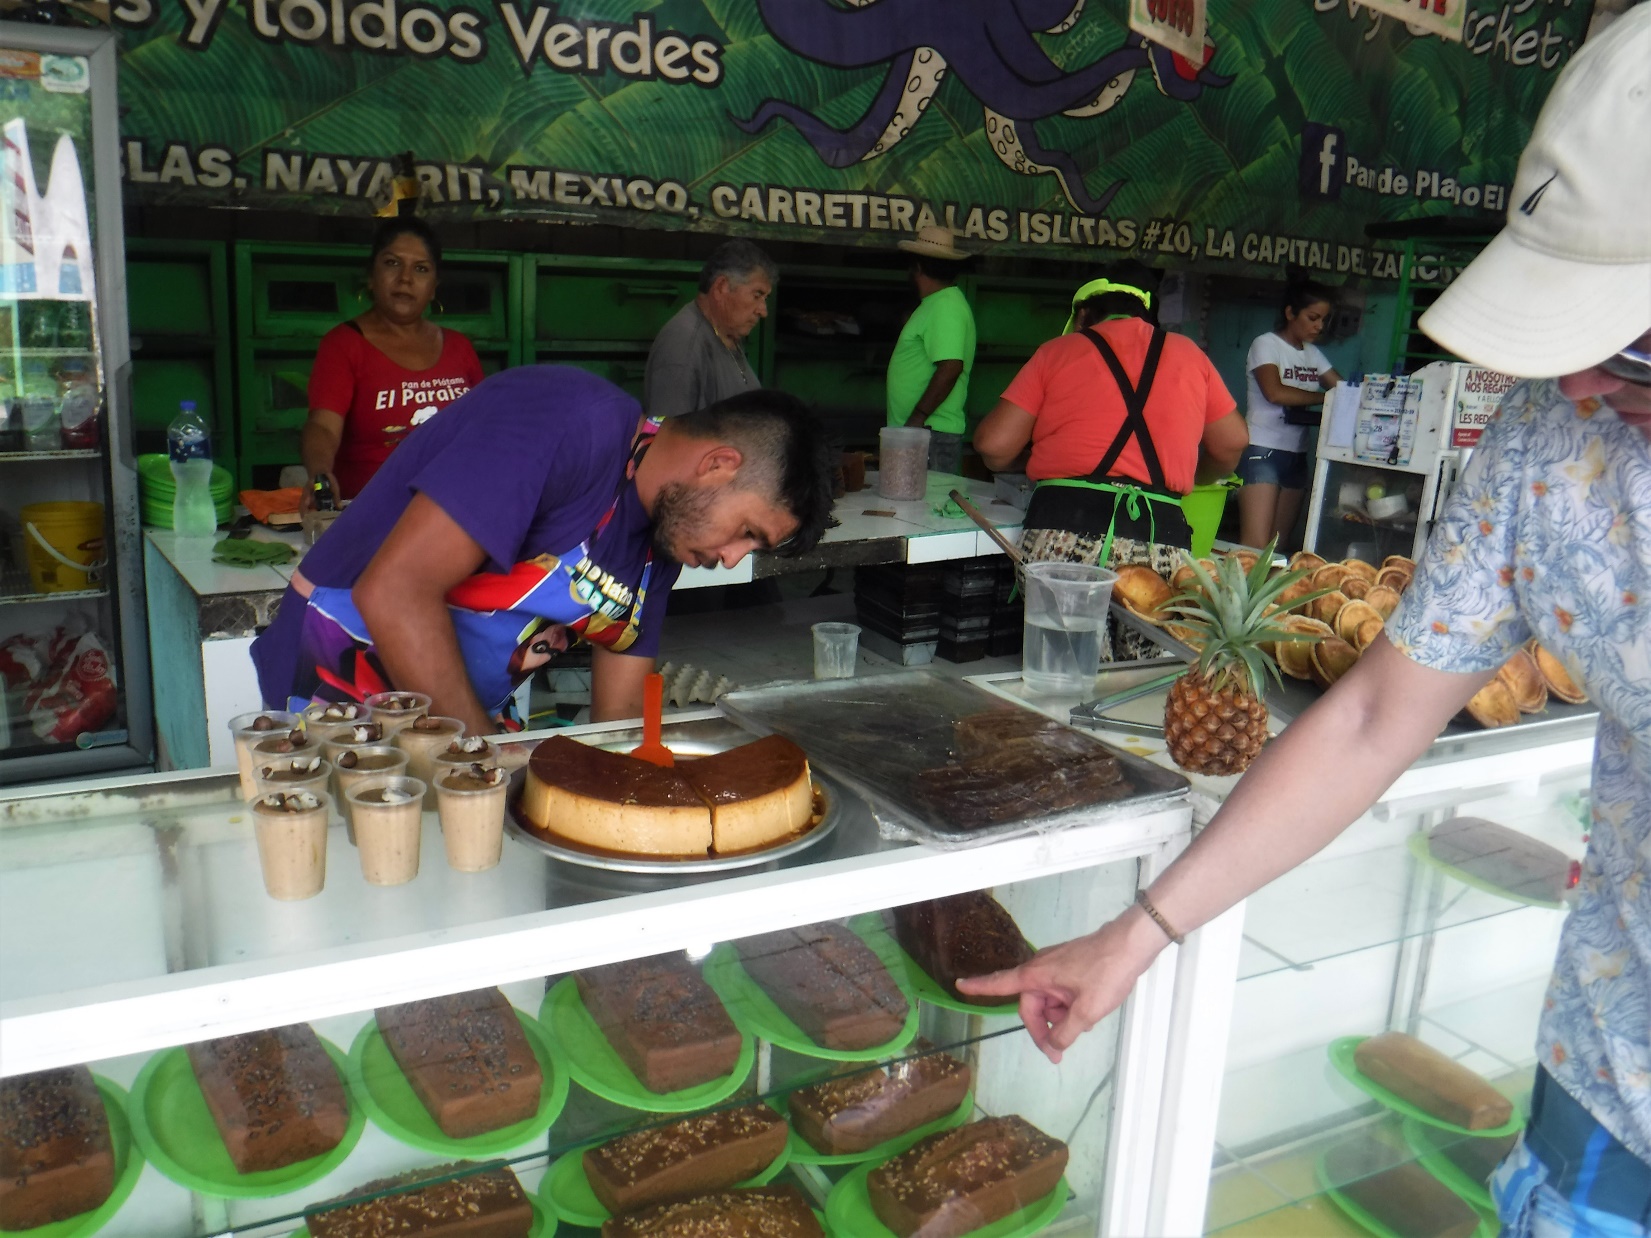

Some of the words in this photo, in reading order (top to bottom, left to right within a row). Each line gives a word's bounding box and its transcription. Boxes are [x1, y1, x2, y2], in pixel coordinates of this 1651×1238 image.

[253, 0, 482, 59] toldos
[501, 2, 722, 84] Verdes
[1345, 157, 1375, 189] Pan
[1378, 168, 1408, 195] de
[1483, 184, 1505, 211] El
[119, 141, 247, 192] LAS,
[266, 152, 500, 208] NAYARIT,
[712, 186, 938, 233] CARRETERA
[945, 205, 1008, 241] LAS
[1019, 211, 1136, 248] ISLITAS
[1142, 221, 1198, 261] #10,
[1206, 228, 1235, 259] LA
[1242, 233, 1332, 271] CAPITAL
[1336, 248, 1367, 276] DEL
[1283, 368, 1293, 379] El
[1466, 370, 1472, 381] A
[1475, 370, 1519, 384] NOSOTRO
[402, 381, 419, 389] Pan
[421, 380, 431, 388] de
[1465, 382, 1481, 393] NOS
[1483, 383, 1512, 394] REGAT
[376, 390, 396, 410] El
[1459, 413, 1472, 424] LES
[1474, 413, 1489, 424] RED
